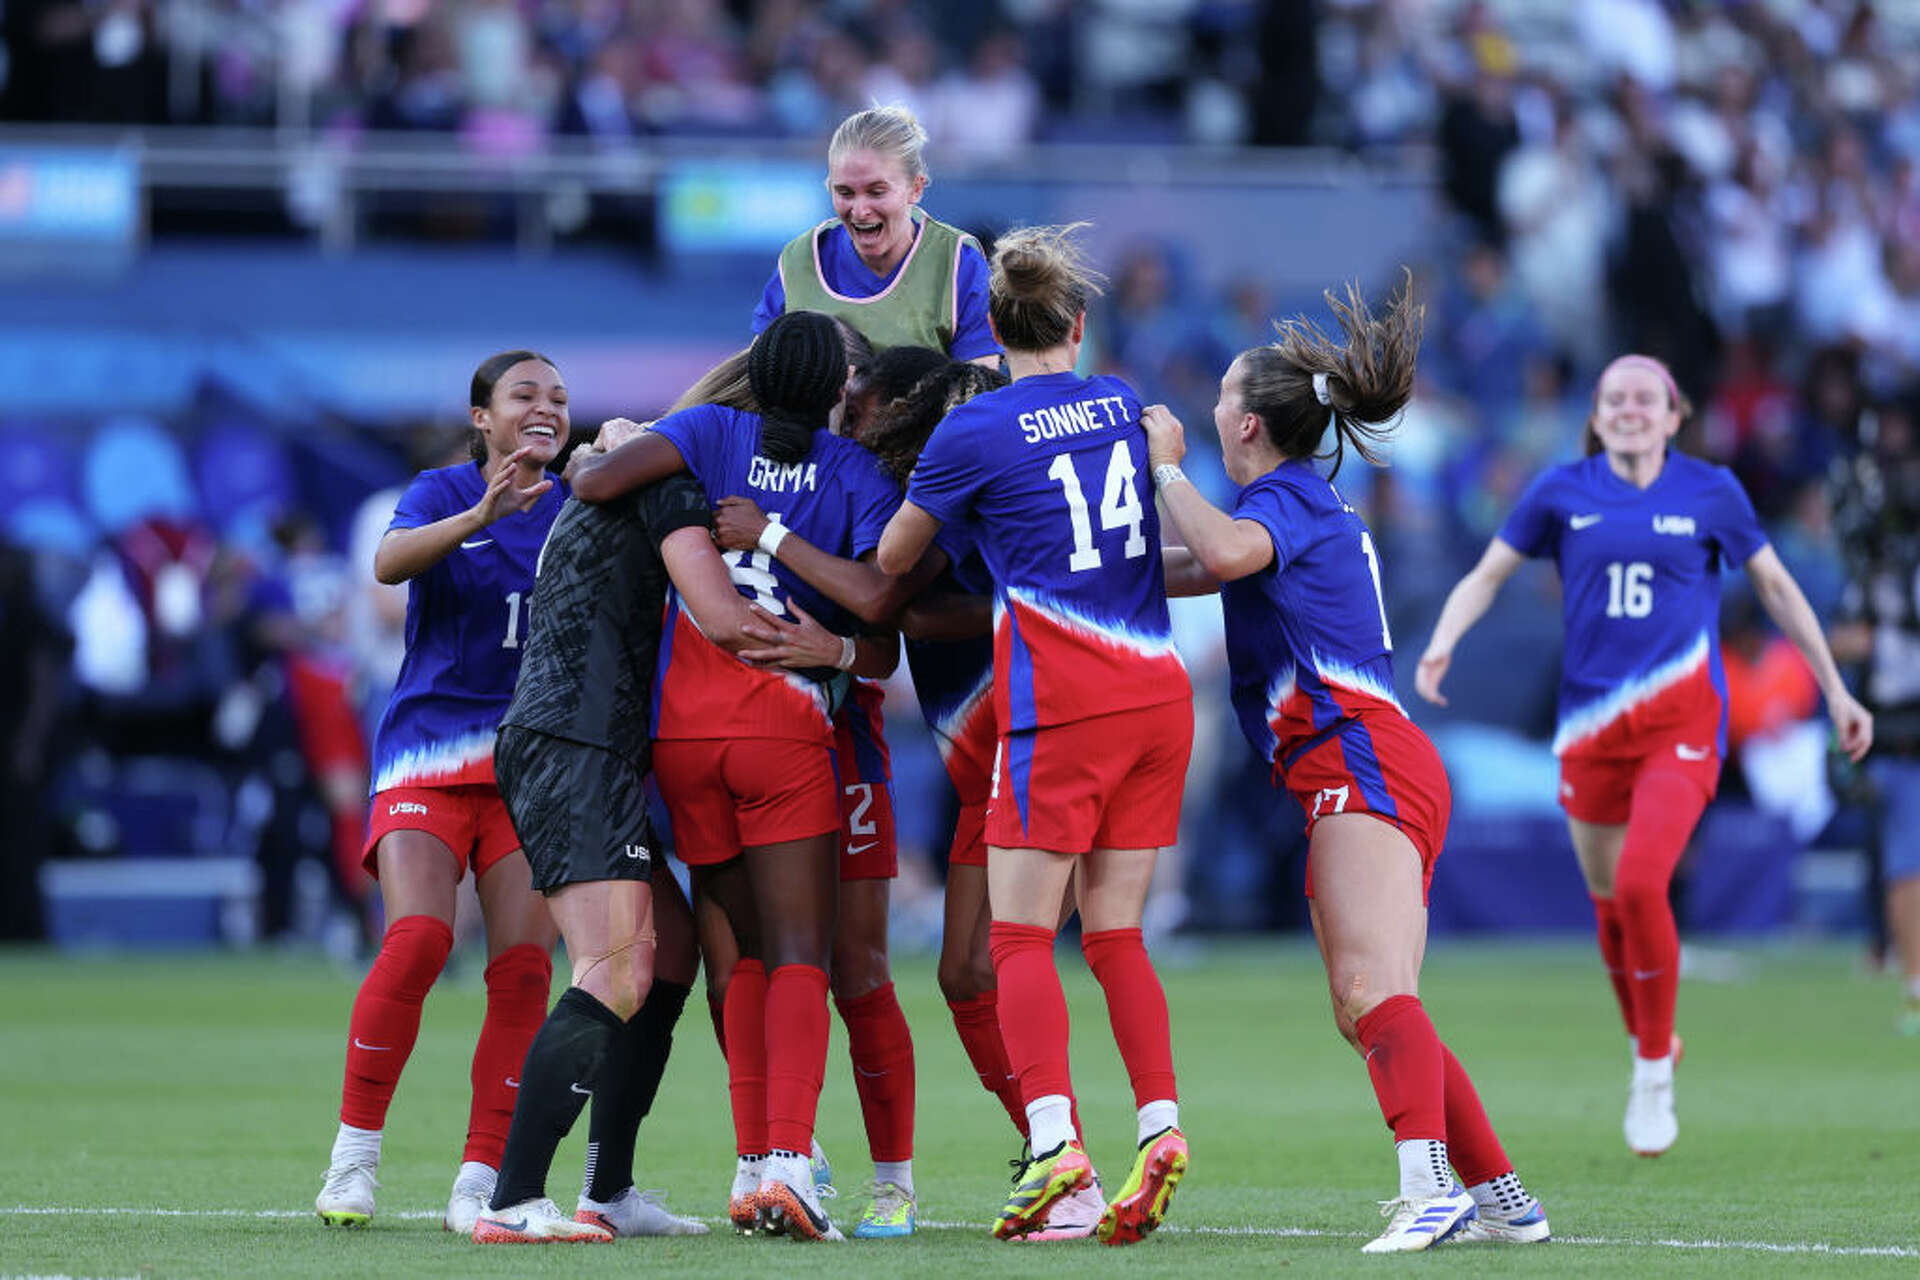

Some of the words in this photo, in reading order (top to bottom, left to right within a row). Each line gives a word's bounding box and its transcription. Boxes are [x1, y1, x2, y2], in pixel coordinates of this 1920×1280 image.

[1018, 396, 1131, 443] SONNETT
[1048, 440, 1146, 572] 14
[1361, 531, 1393, 651] 1
[1606, 561, 1654, 619] 16
[389, 802, 427, 816] USA
[845, 783, 877, 835] 2
